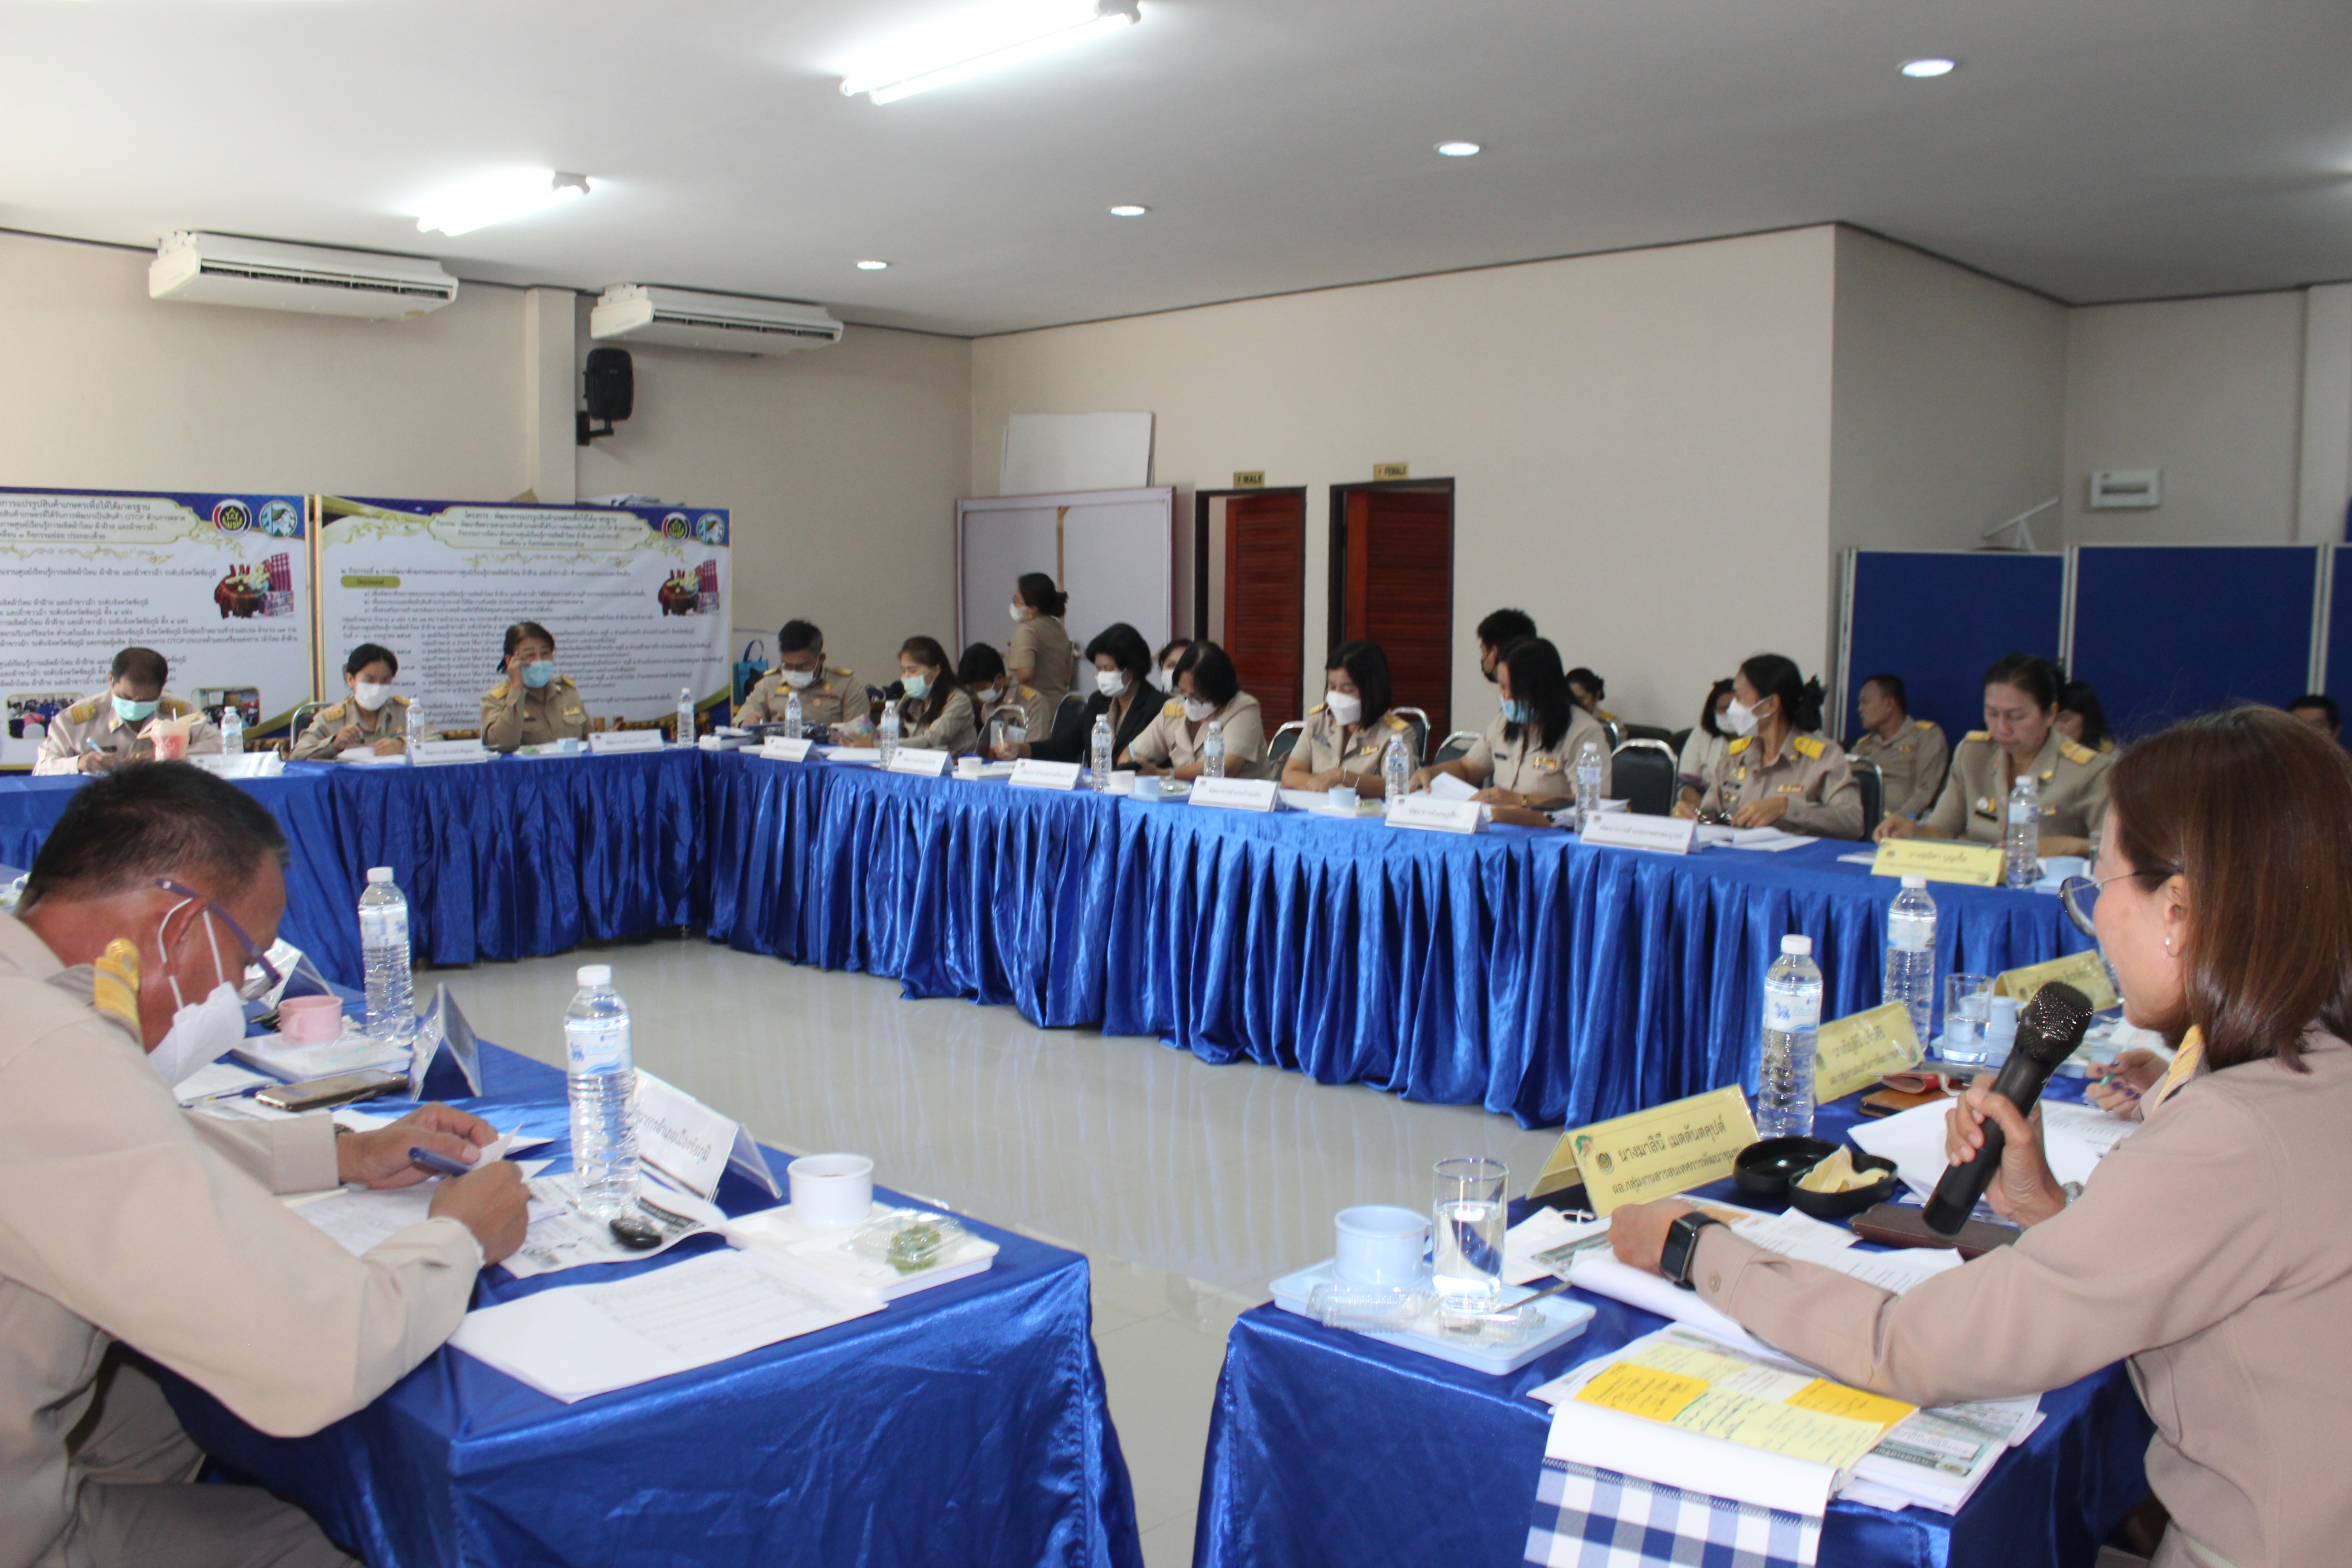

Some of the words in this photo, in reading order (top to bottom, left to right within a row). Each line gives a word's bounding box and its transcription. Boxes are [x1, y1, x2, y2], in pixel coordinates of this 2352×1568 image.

[1384, 466, 1406, 475] FEMALE
[1617, 1132, 1666, 1162] นางมาลินี
